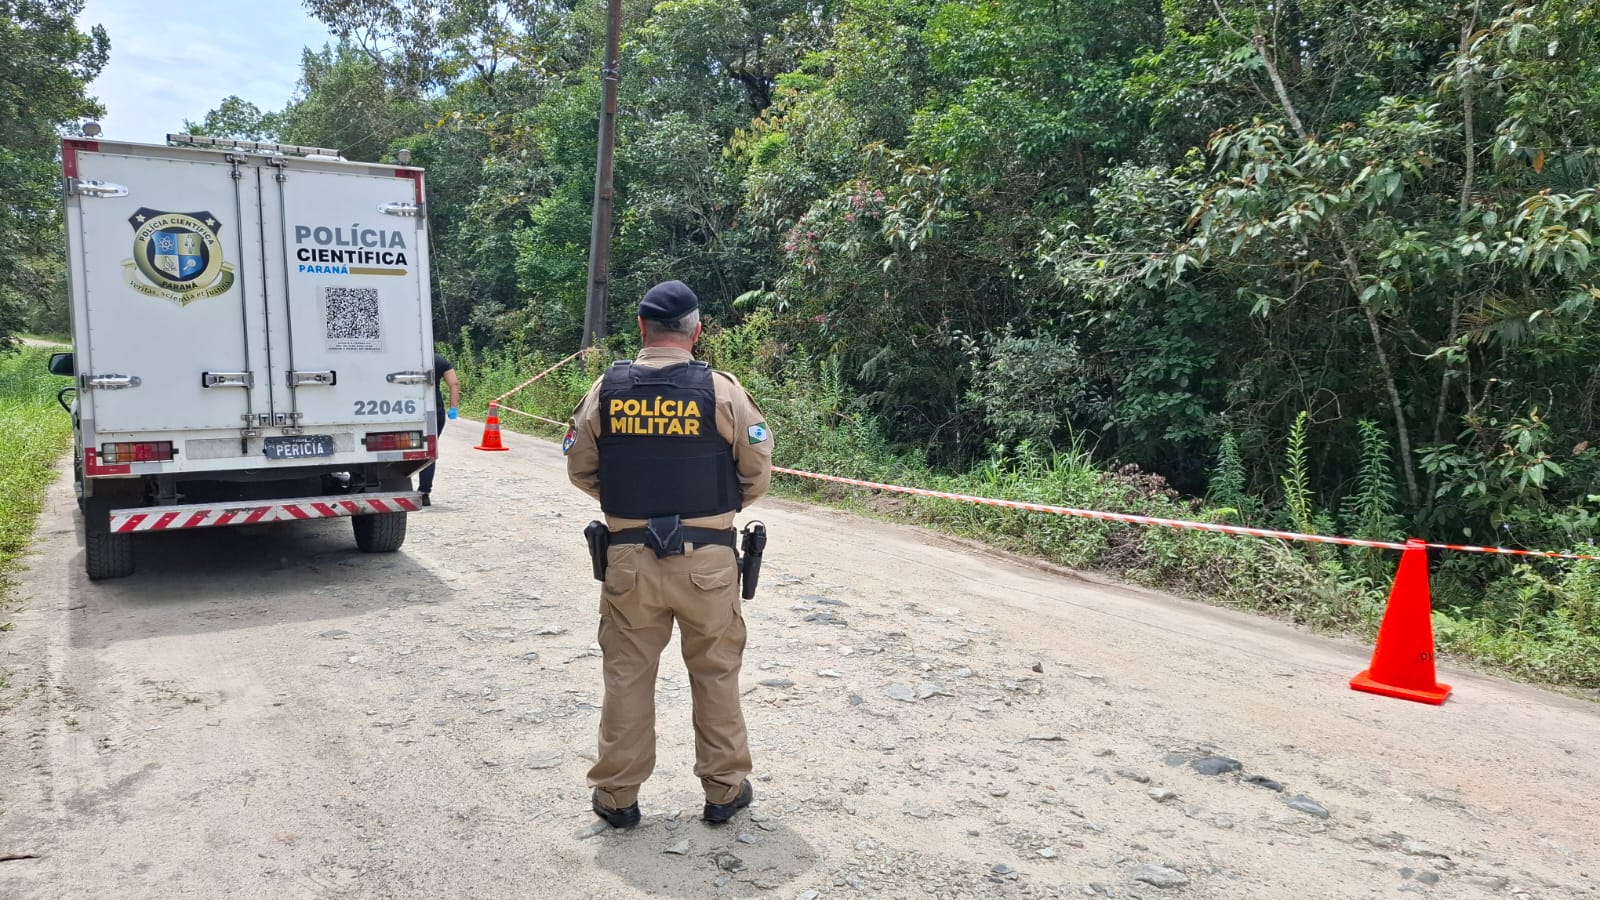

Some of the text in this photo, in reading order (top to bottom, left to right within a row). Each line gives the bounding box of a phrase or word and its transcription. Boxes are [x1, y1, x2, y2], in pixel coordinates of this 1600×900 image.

[139, 218, 215, 246] POLÍCIA CIENTÍFICA
[295, 223, 407, 249] POLÍCIA
[297, 247, 408, 266] CIENTÍFICA
[298, 264, 348, 275] PARANÁ
[161, 280, 198, 291] PARANÁ
[353, 399, 416, 416] 22046
[609, 395, 701, 418] POLÍCIA
[610, 416, 700, 436] MILITAR
[276, 442, 324, 457] PERICIA
